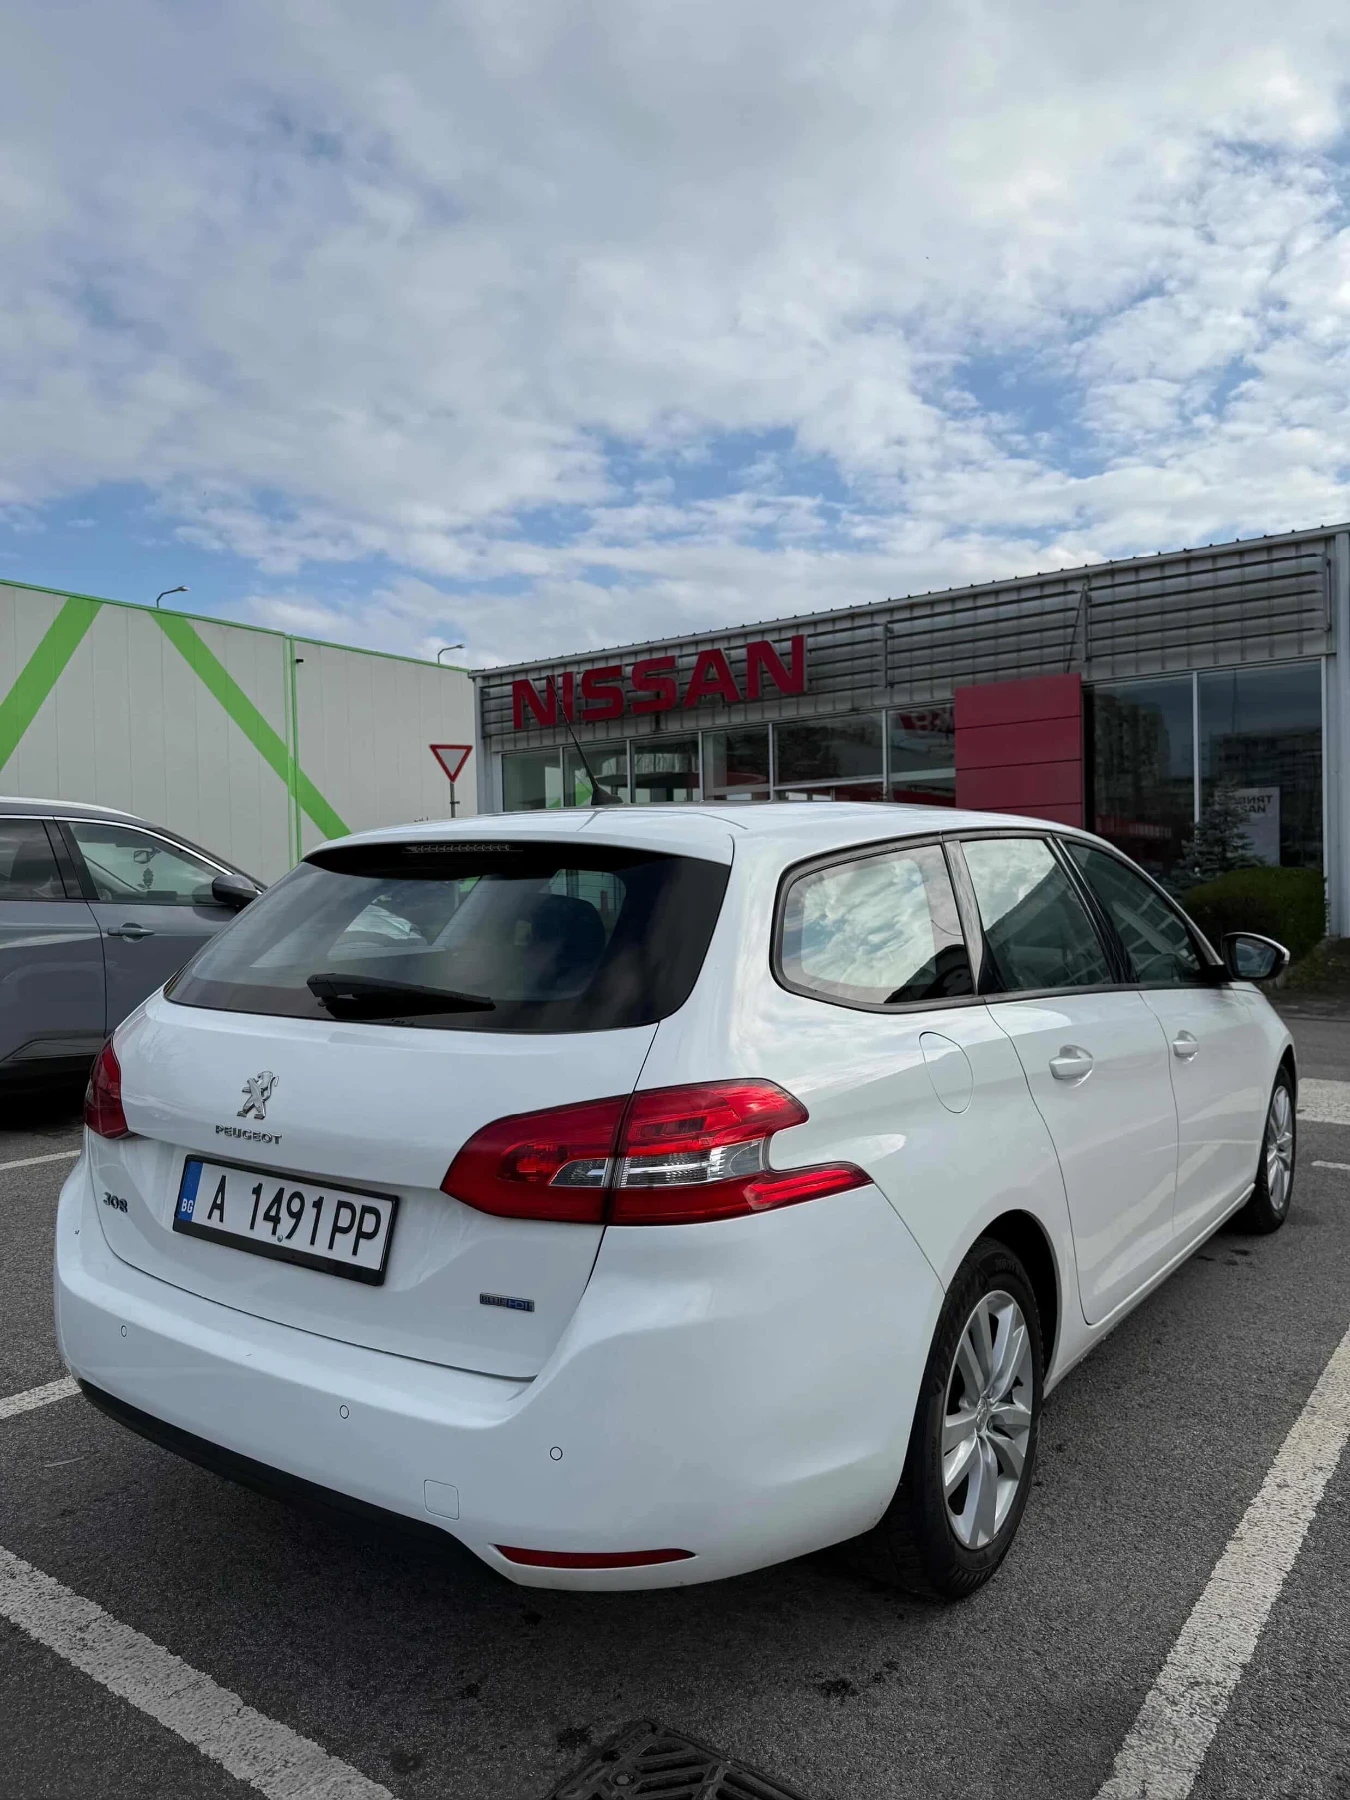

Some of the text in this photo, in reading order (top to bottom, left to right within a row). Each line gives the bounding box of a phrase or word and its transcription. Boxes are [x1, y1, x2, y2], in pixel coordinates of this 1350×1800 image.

[512, 634, 806, 729] NISSAN
[215, 1124, 282, 1145] PEUGEOT
[103, 1191, 128, 1213] 308
[181, 1198, 194, 1214] BG
[207, 1175, 227, 1223] A
